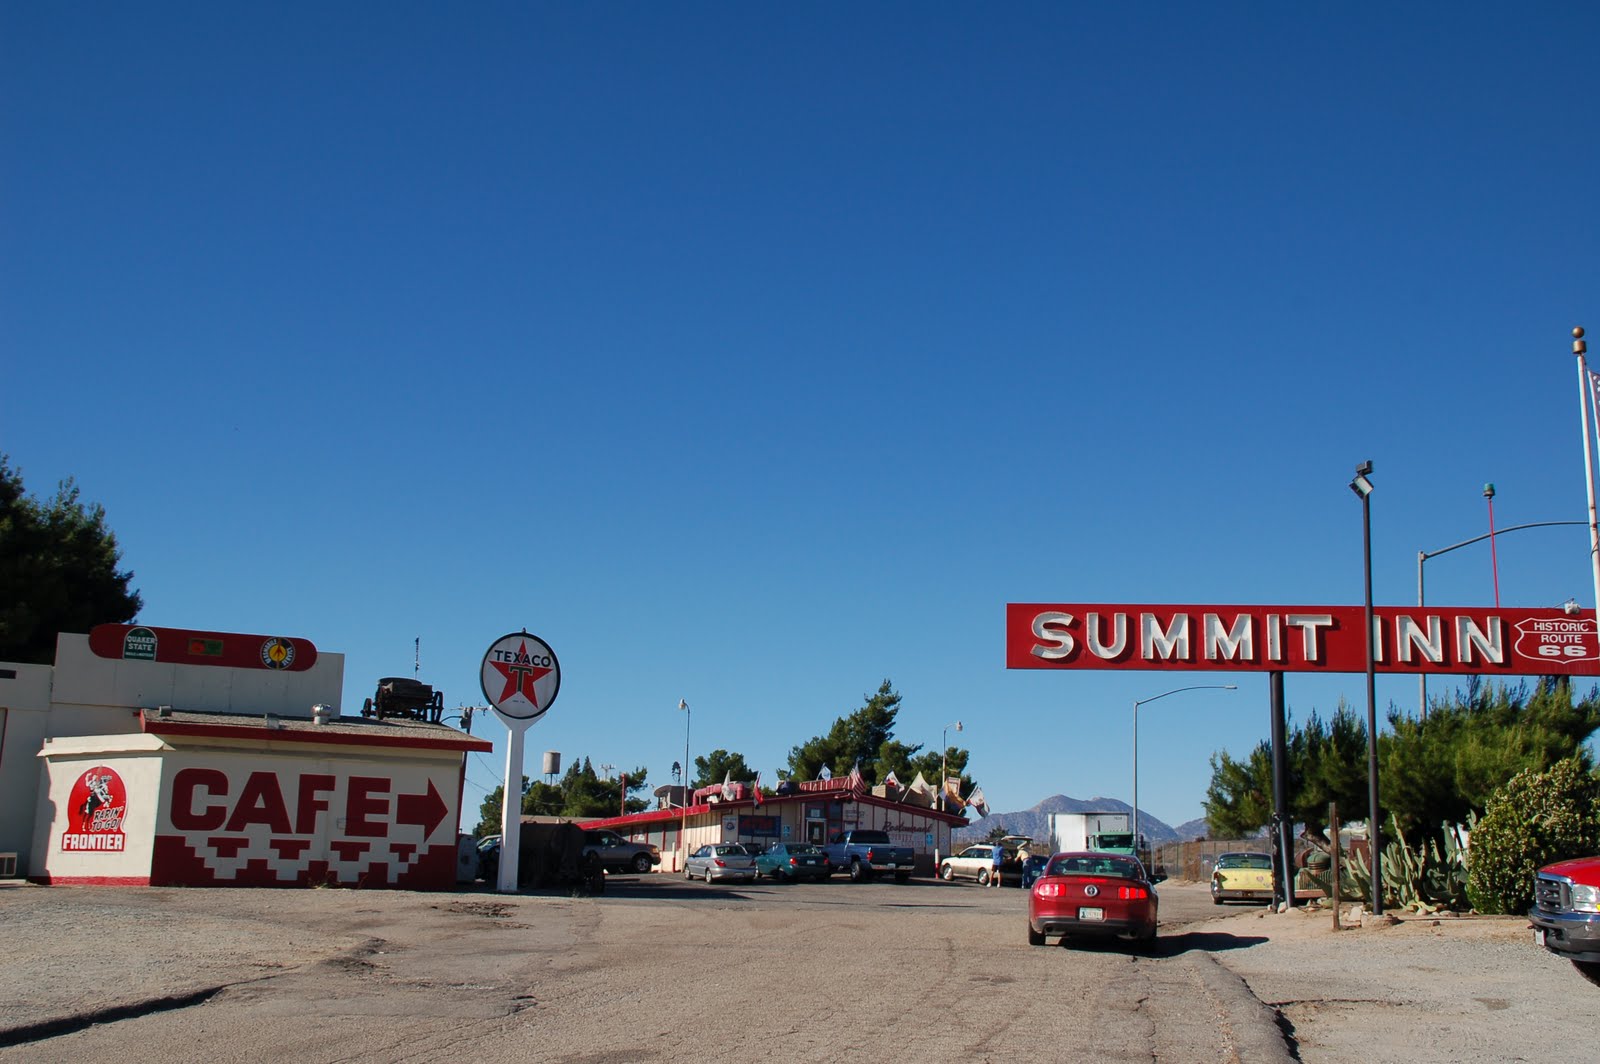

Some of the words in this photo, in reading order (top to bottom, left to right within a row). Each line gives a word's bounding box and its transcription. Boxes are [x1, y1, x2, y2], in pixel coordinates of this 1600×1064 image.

[1533, 622, 1589, 632] HISTORIC
[126, 635, 156, 645] QUAKER
[1030, 611, 1333, 661] SUMMIT
[1372, 614, 1504, 663] INN
[1541, 634, 1583, 644] ROUTE
[128, 643, 153, 651] STATE
[1538, 645, 1587, 657] 66
[494, 650, 551, 667] TEXACO
[510, 666, 533, 692] T
[170, 768, 392, 838] CAFE
[91, 821, 103, 832] TO
[882, 820, 933, 833] Restaurant
[63, 834, 123, 849] FRONTIER
